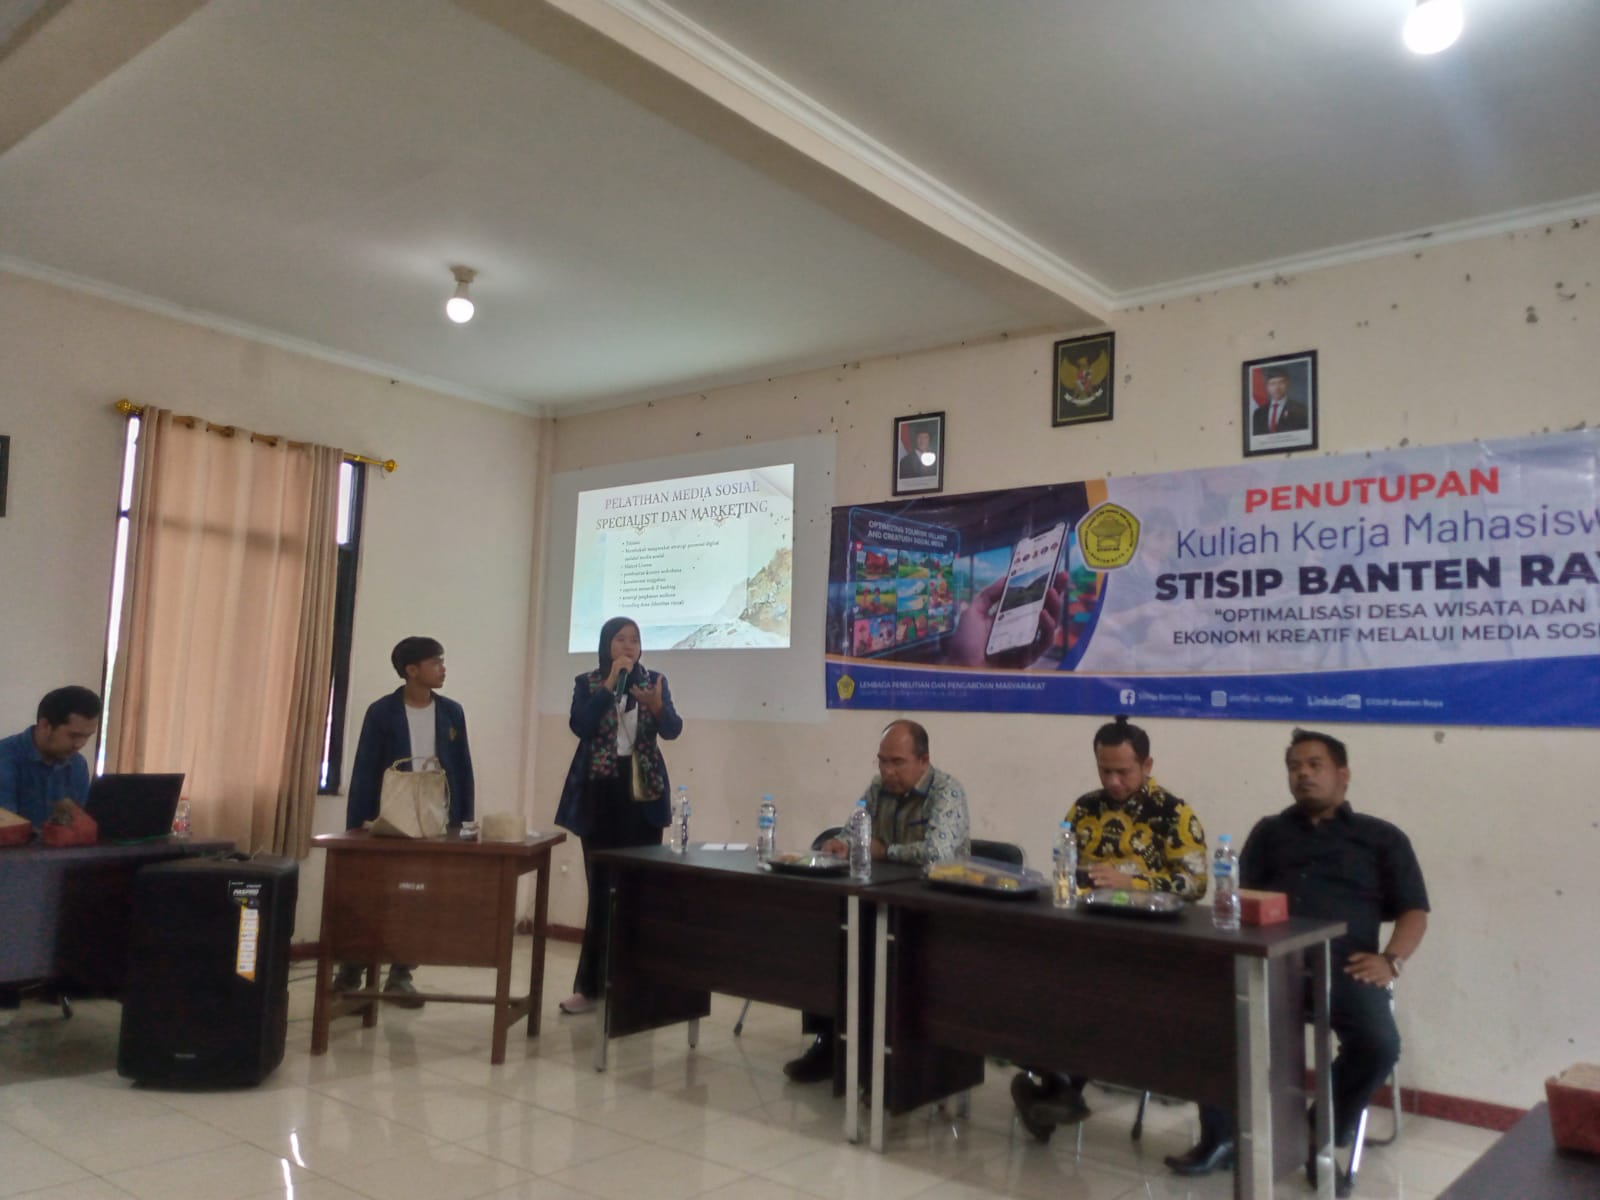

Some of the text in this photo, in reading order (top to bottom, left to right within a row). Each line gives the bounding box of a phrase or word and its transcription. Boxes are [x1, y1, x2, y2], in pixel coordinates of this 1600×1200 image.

[605, 480, 760, 510] PELATIHAN MEDIA SOSIAL
[1245, 466, 1499, 514] PENUTUPAN
[596, 500, 768, 530] SPECIALIST DAN MARKETING
[1177, 524, 1279, 559] Kuliah
[1293, 516, 1389, 556] Kerja
[1155, 551, 1600, 601] STISIP BANTEN RA
[1368, 603, 1428, 619] DESA
[1434, 600, 1524, 618] WISATA
[1531, 598, 1585, 616] DAN
[1173, 630, 1260, 645] EKONOMI
[1267, 627, 1351, 643] KREATIF
[1357, 625, 1454, 642] MELALUI
[1462, 623, 1540, 641] MEDIA
